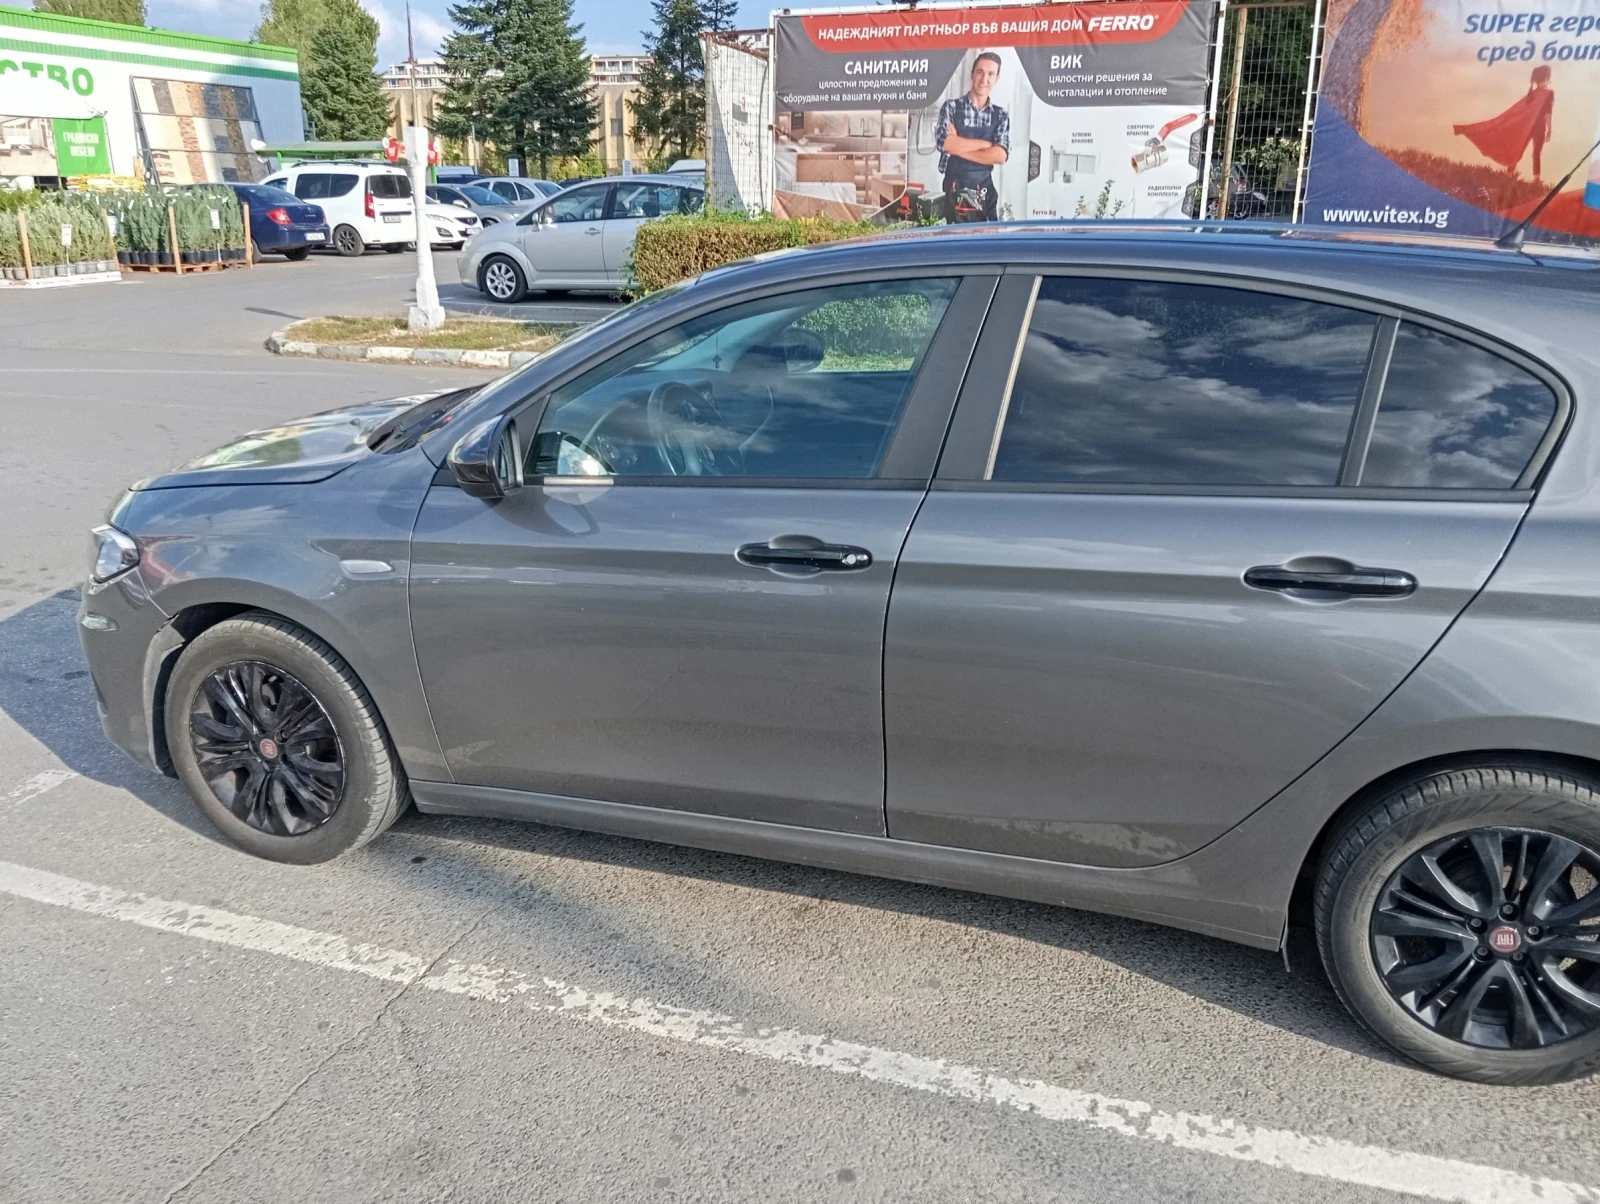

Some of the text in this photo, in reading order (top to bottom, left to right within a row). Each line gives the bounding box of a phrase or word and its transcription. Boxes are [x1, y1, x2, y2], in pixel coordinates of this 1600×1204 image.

[818, 14, 1155, 42] НАДЕЖДНИЯТ ПАРТНЬОР ВЪВ ВАШИЯ ДОМ FERRO
[1463, 13, 1545, 34] SUPER
[1477, 40, 1536, 67] сред
[844, 59, 929, 75] САНИТАРИЯ
[1050, 54, 1083, 69] ВИК
[818, 78, 928, 90] цялостни предложения за
[1048, 73, 1153, 85] цялостни решения за
[783, 90, 927, 105] оборудване на вашата кухня и баня
[1047, 86, 1168, 98] инсталации и отопление
[1323, 205, 1450, 228] www.vitex.bg
[1496, 933, 1514, 945] FIAT
